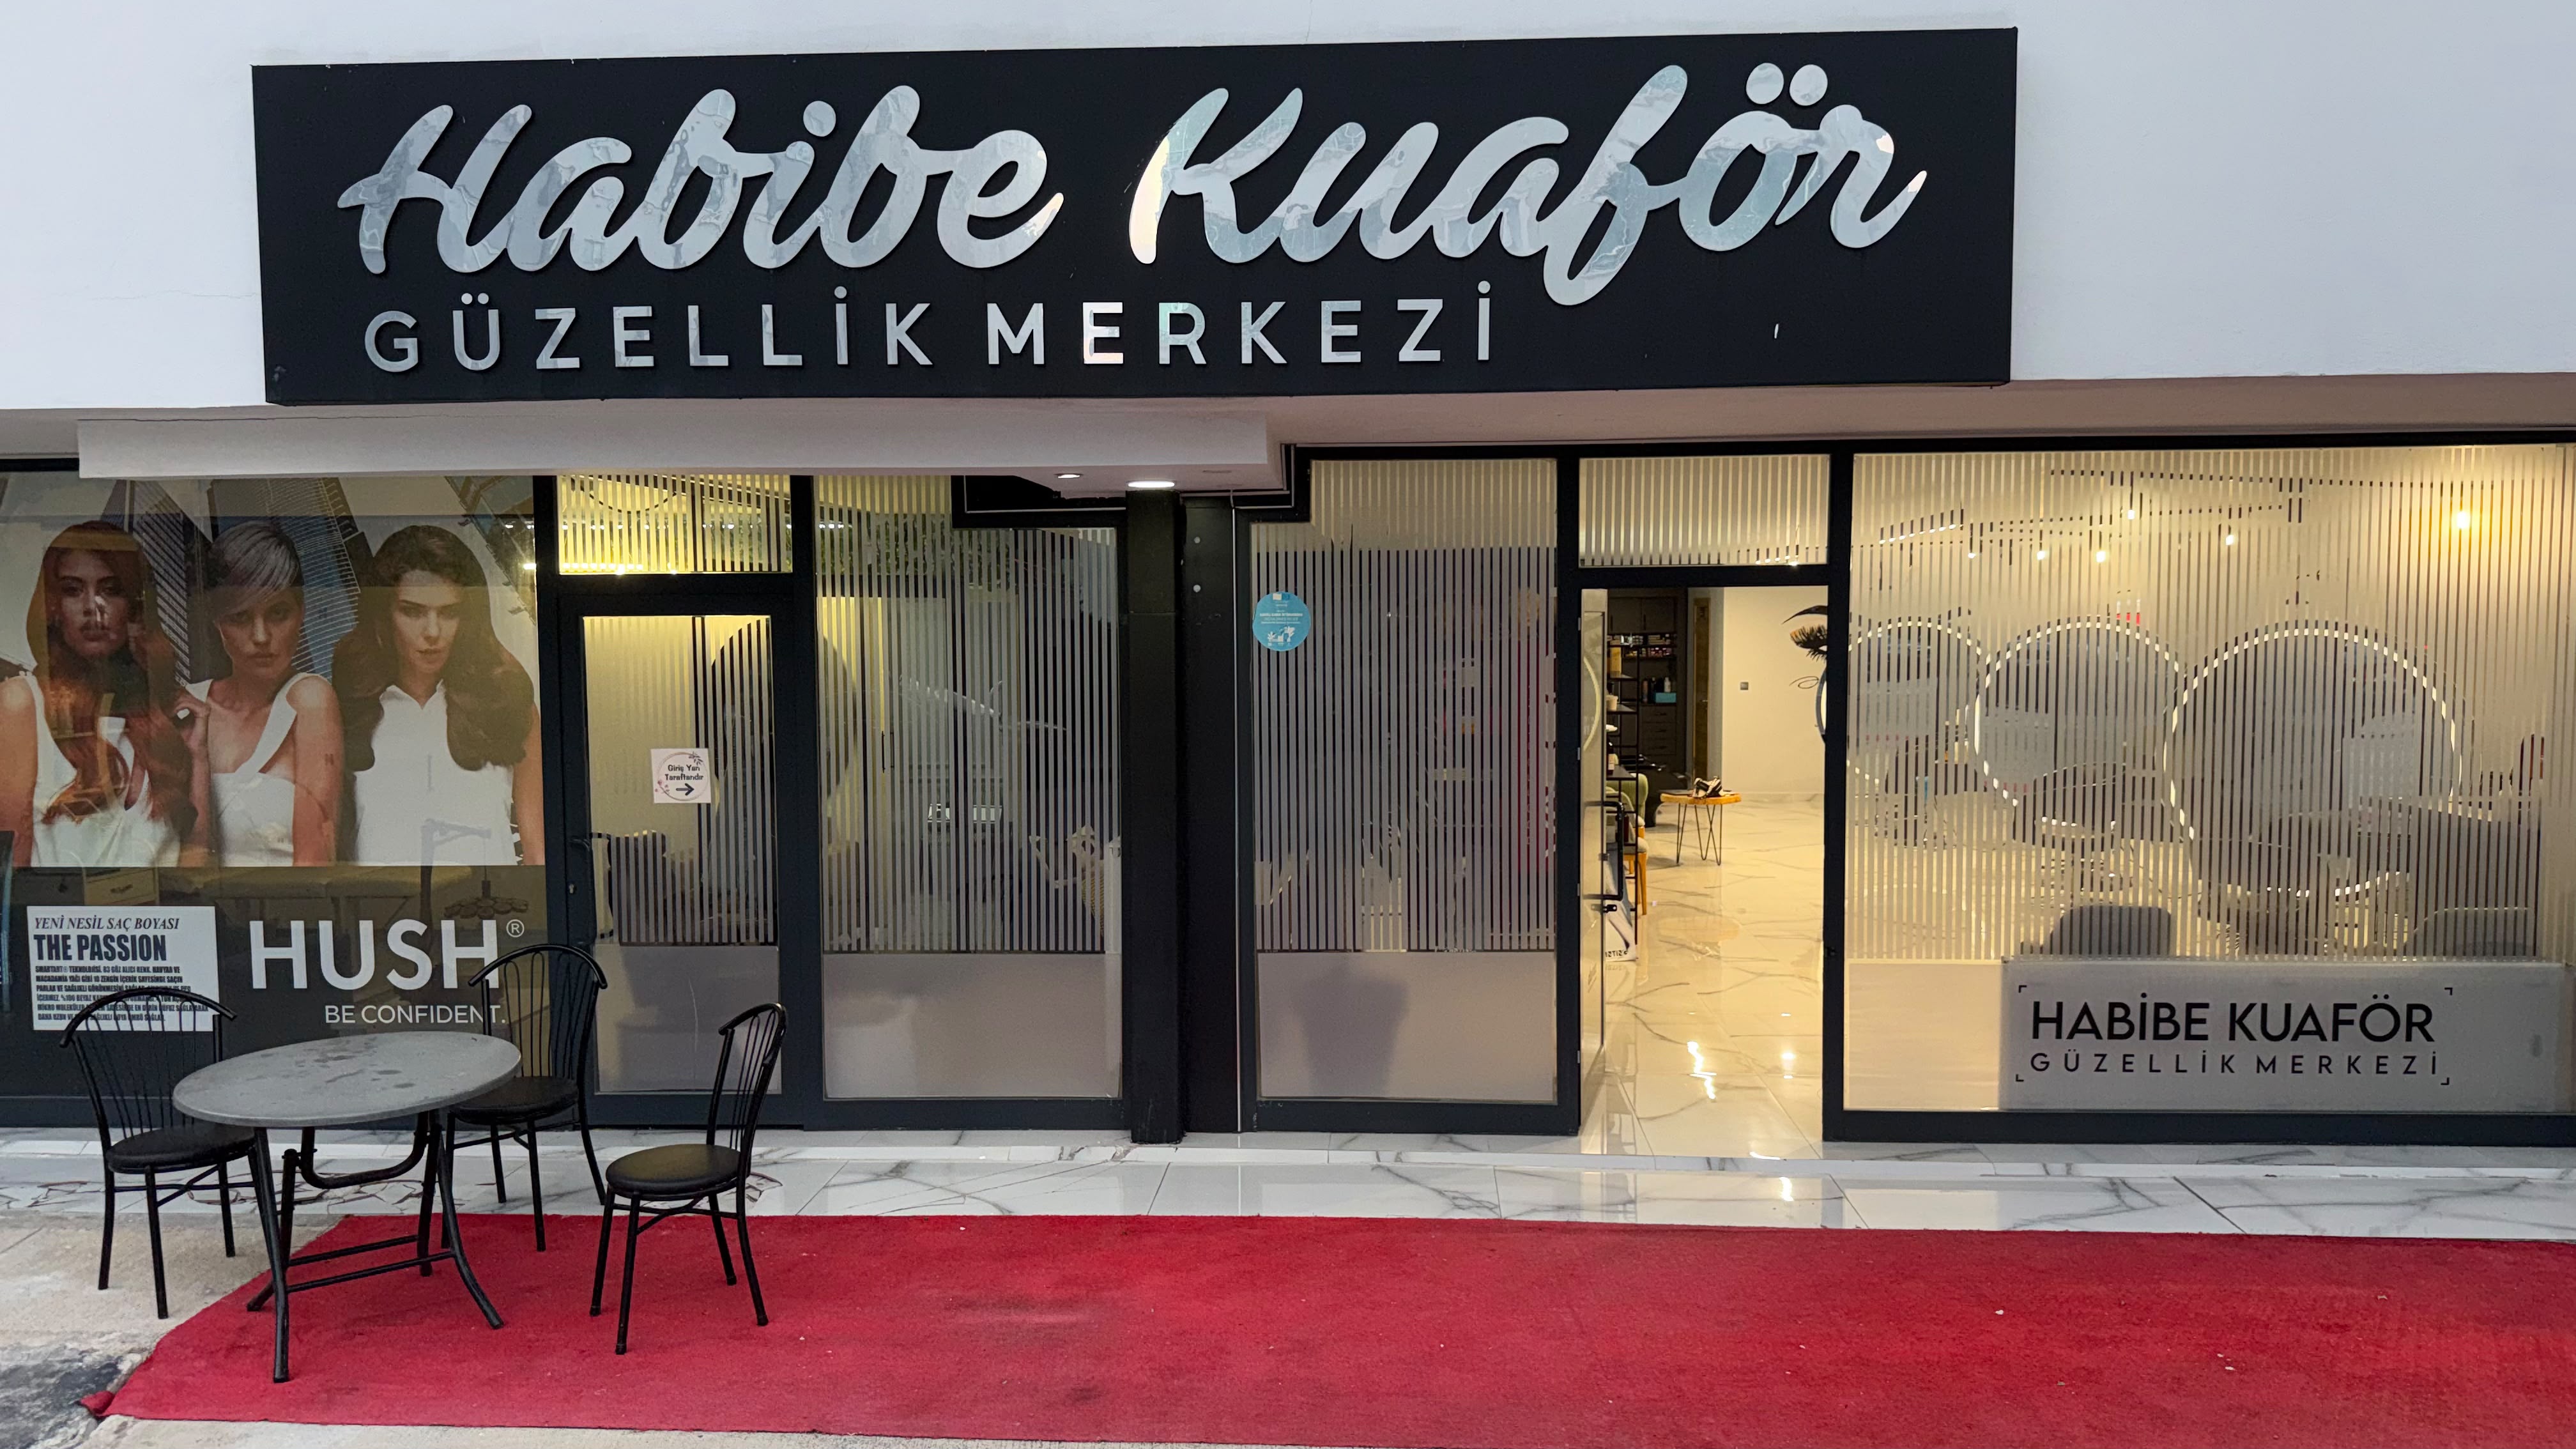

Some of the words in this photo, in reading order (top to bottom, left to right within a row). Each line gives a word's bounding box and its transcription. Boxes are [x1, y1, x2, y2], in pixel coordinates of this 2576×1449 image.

[337, 85, 1064, 274] Habibe
[1128, 62, 1927, 305] Kuaför
[365, 286, 933, 372] GÜZELLİK
[987, 281, 1491, 365] MERKEZİ
[668, 764, 684, 772] Giriş
[35, 915, 64, 929] YENİ
[67, 915, 105, 929] NESİL
[107, 918, 132, 931] SAÇ
[134, 917, 180, 930] BOYASI
[33, 934, 72, 961] THE
[77, 934, 167, 962] PASSION
[325, 1004, 355, 1023] BE
[2032, 992, 2210, 1041] HABİBE
[2230, 994, 2435, 1043] KUAFÖR
[2030, 1048, 2236, 1073] GÜZELLİK
[2256, 1050, 2437, 1075] MERKEZİ
